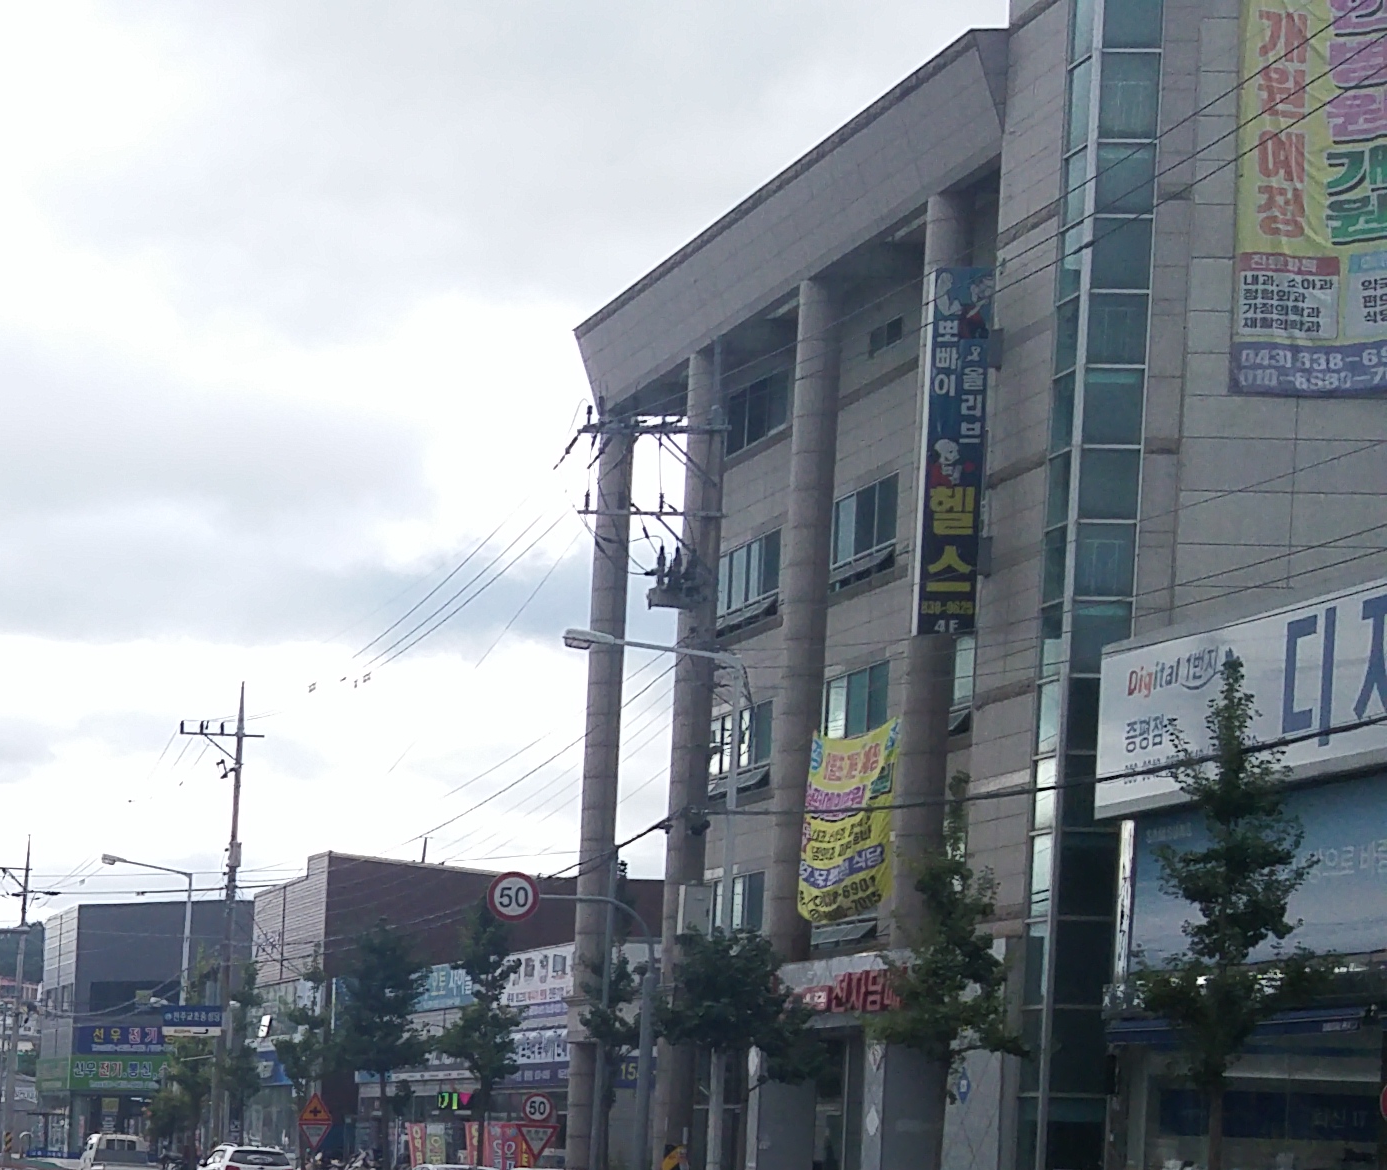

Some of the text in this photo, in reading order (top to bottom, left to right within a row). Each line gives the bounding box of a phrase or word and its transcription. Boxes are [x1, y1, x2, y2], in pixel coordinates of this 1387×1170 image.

[1257, 9, 1308, 238] 개원 예정
[1243, 287, 1307, 303] 정형외과
[1286, 278, 1334, 291] 소아과
[1242, 302, 1321, 319] 가정의학과
[1242, 316, 1321, 333] 재활의학과
[934, 319, 959, 396] 뽀빠이
[959, 367, 984, 444] 올리브
[926, 486, 976, 592] 헬스
[934, 619, 960, 634] 4F
[1128, 645, 1219, 698] Digital 1번지
[1124, 713, 1165, 753] 증평점
[850, 845, 883, 869] 식당
[498, 886, 529, 909] 50
[73, 1061, 97, 1078] 선우
[528, 1101, 547, 1116] 50
